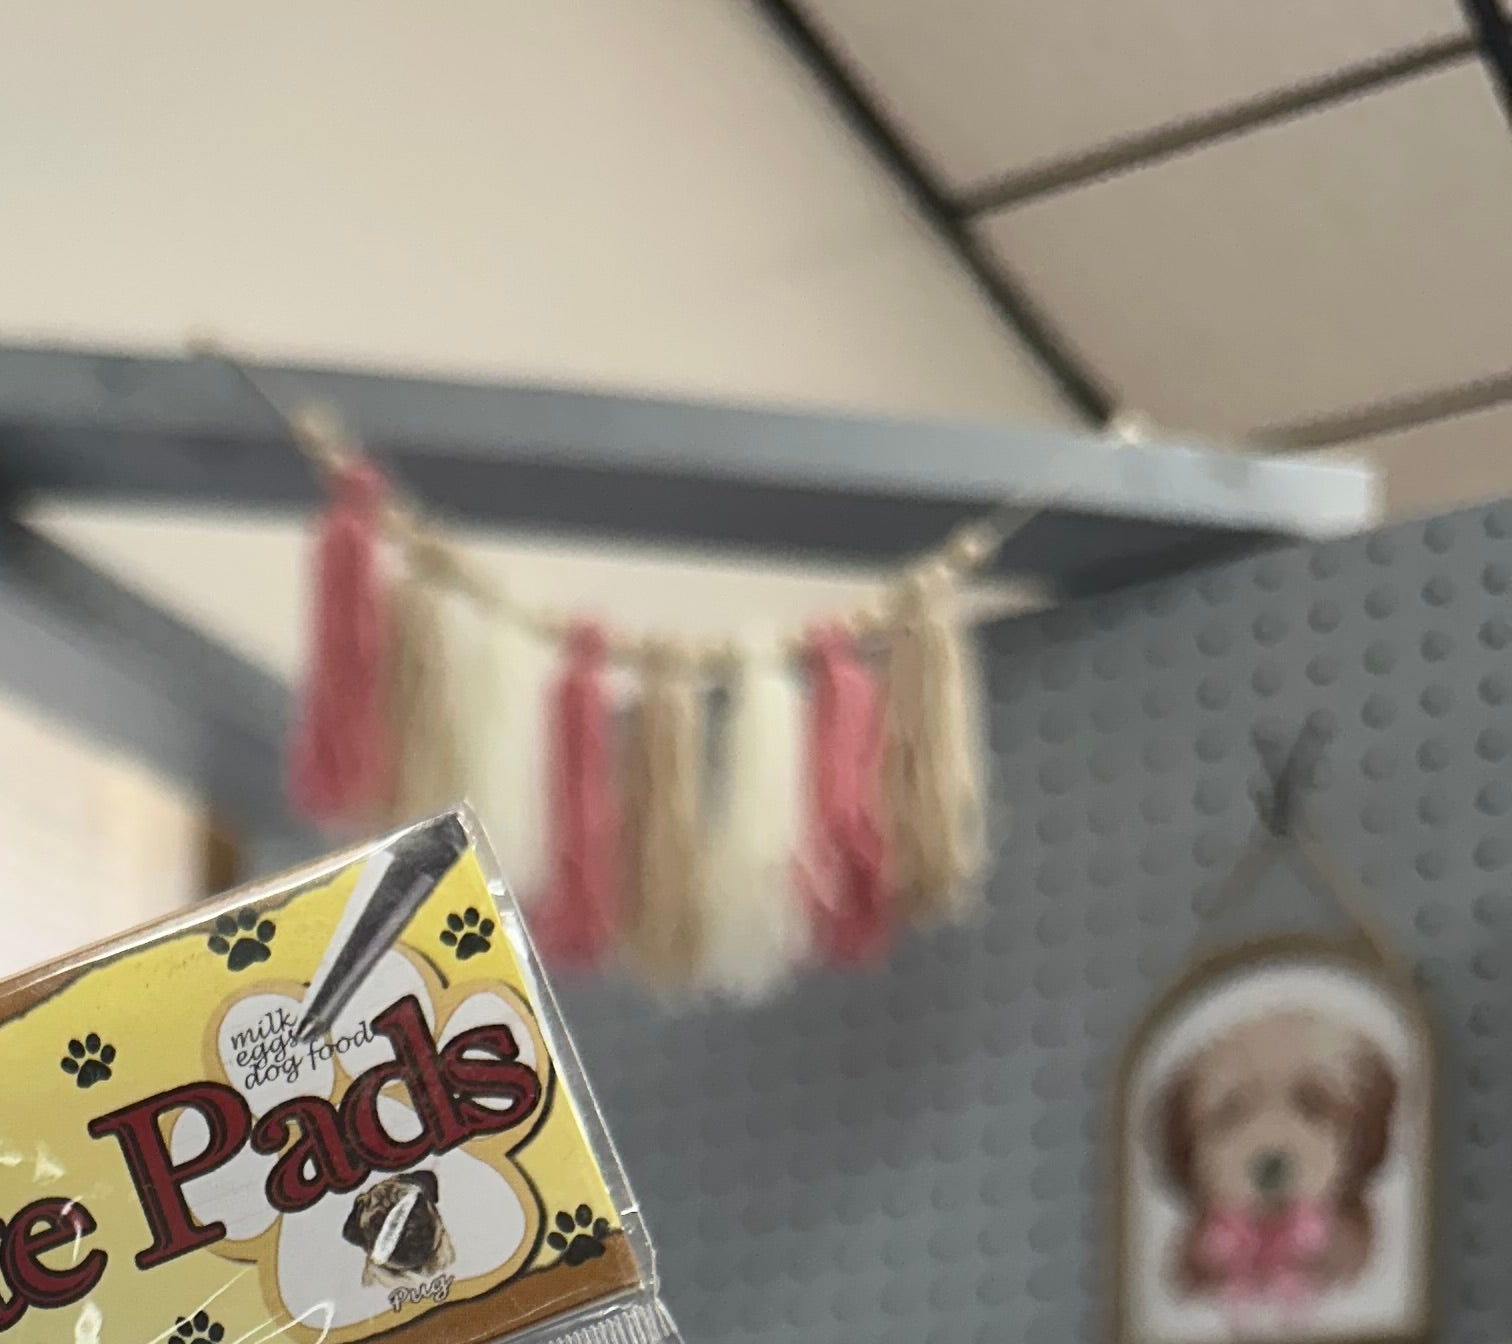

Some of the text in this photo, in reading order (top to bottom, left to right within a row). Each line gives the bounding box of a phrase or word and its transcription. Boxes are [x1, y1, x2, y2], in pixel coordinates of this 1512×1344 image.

[230, 1008, 297, 1050] milk
[237, 1030, 299, 1069] eggs
[245, 1021, 375, 1089] dog food
[86, 994, 541, 1273] Pads
[387, 1273, 456, 1313] Pug
